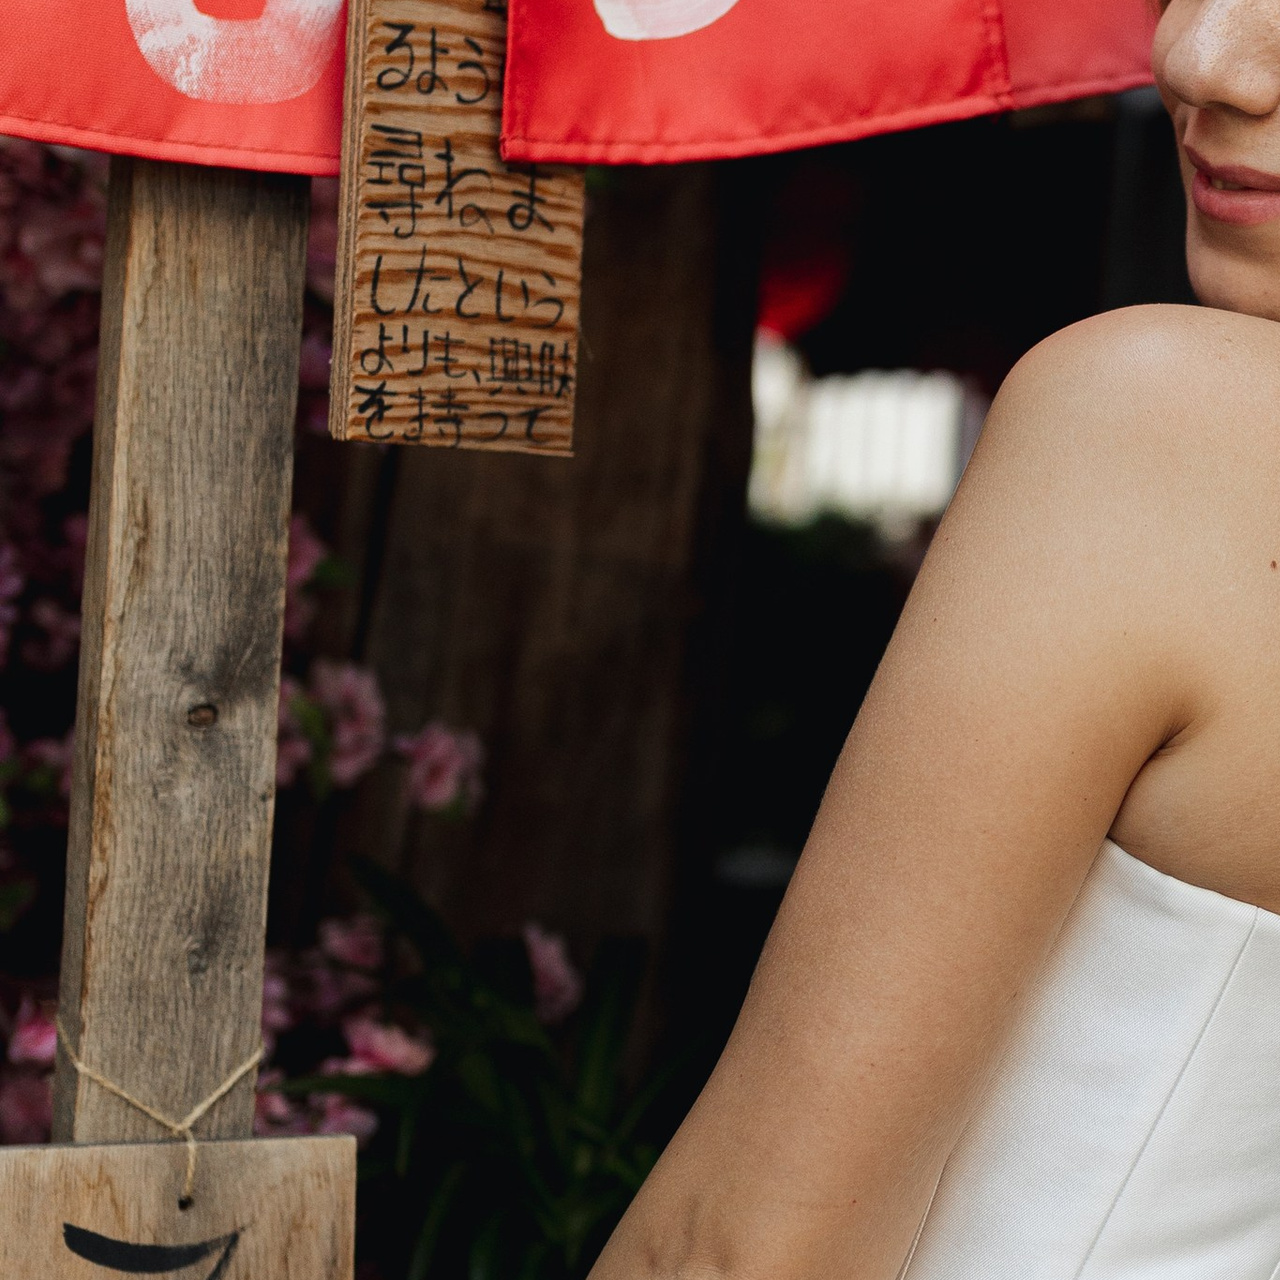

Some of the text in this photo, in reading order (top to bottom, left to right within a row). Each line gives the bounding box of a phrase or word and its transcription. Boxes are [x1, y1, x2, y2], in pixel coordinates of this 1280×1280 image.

[376, 22, 492, 105] るよう
[369, 243, 565, 330] したという
[354, 380, 555, 449] を持って
